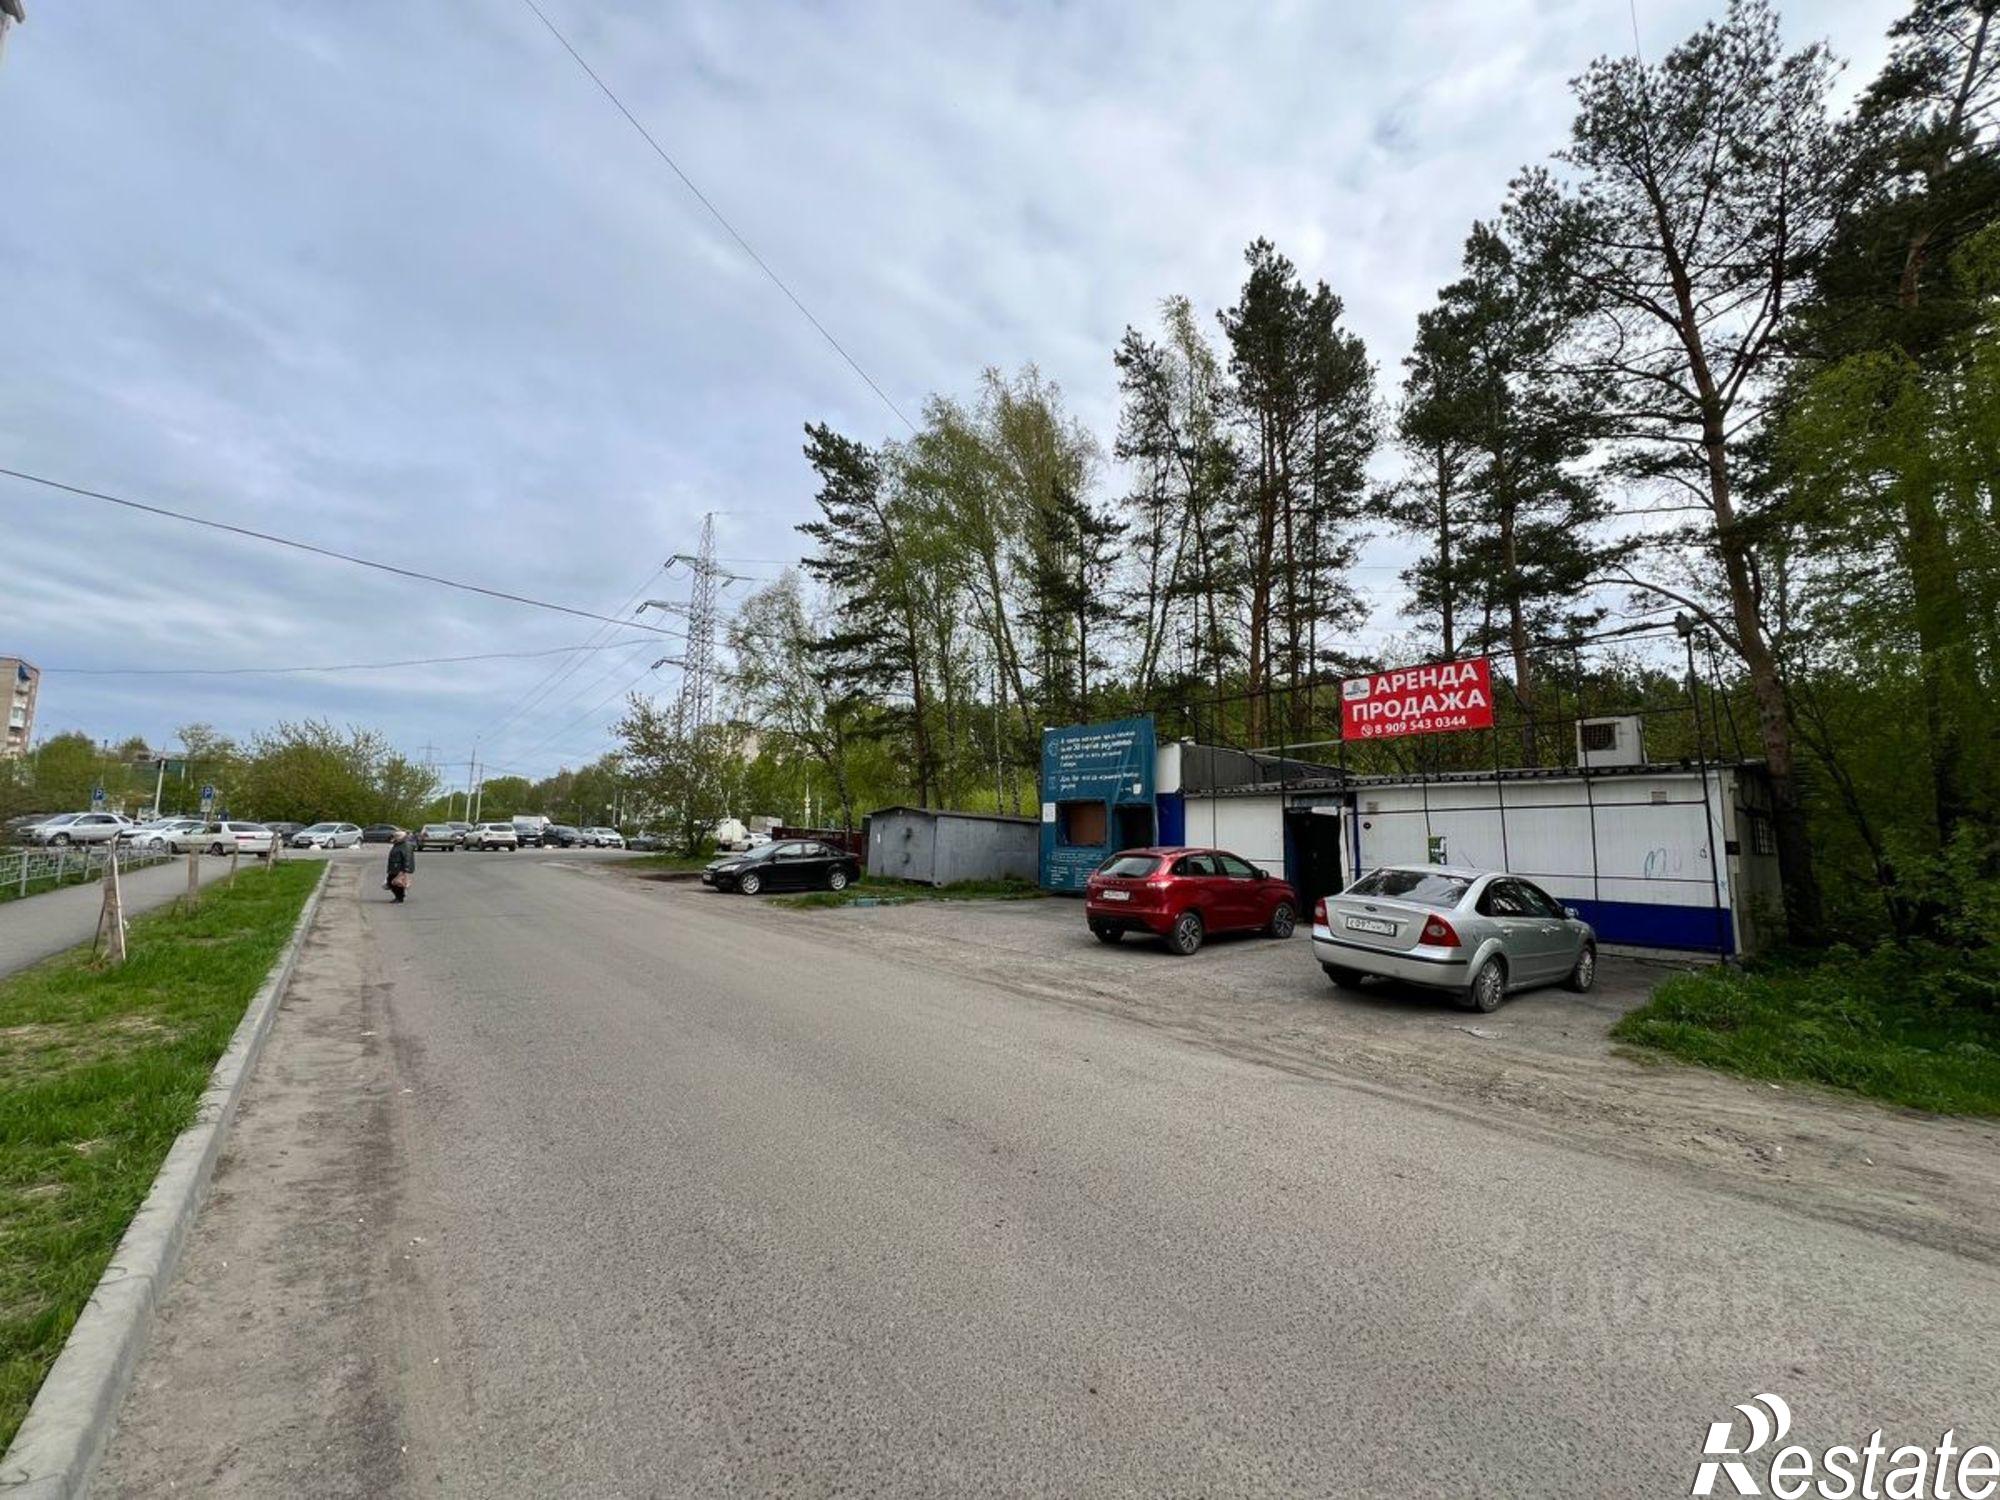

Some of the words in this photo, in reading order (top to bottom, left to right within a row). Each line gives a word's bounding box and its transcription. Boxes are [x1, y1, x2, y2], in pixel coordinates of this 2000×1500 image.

[1375, 663, 1478, 695] АРЕНДА
[1352, 689, 1486, 722] ПРОДАЖА
[1374, 724, 1382, 734] 8
[1385, 721, 1406, 733] 909
[1410, 718, 1431, 730] 543
[1435, 715, 1467, 728] 0344
